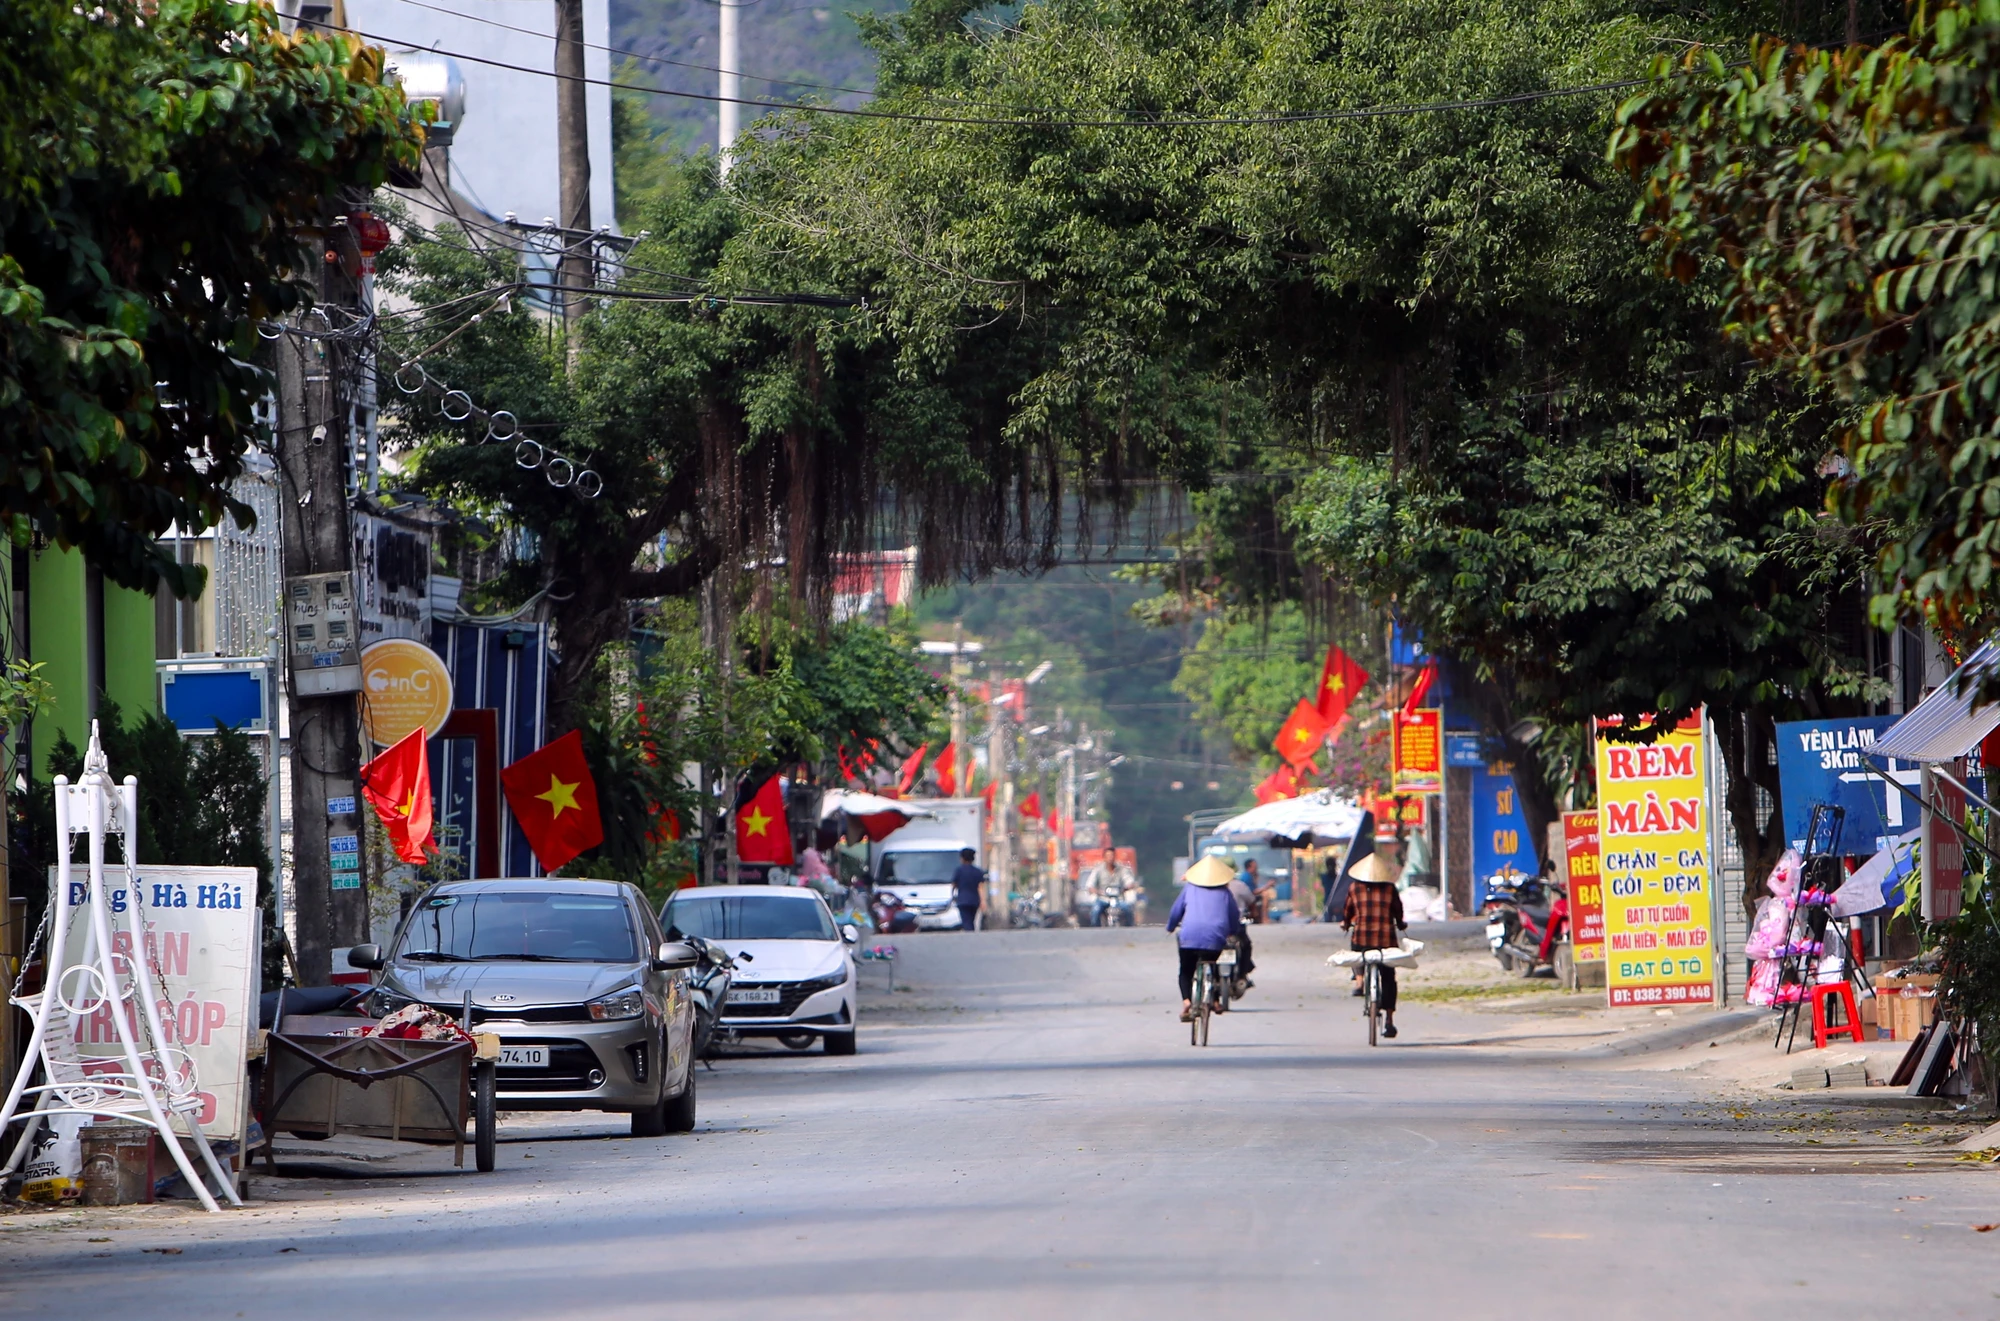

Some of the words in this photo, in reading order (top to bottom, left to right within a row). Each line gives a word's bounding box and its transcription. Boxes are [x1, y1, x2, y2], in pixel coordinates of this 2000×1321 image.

[1799, 728, 1834, 752] YÊN
[1837, 726, 1875, 749] LÂM
[1820, 750, 1859, 769] 3Km
[1606, 792, 1699, 834] MÀN
[1493, 829, 1518, 855] CAO
[1607, 849, 1656, 870] CHĂN
[1678, 850, 1704, 868] GA
[1663, 872, 1701, 895] ĐỆM
[151, 884, 188, 908] Hà
[196, 882, 242, 909] Hải
[1577, 885, 1603, 909] BẠ
[1612, 931, 1632, 950] MÁI
[1667, 929, 1686, 947] MÁI
[1621, 961, 1655, 980] BẠT
[1661, 957, 1673, 975] Ô
[1678, 956, 1701, 974] TÔ
[1613, 989, 1631, 1002] ĐT:
[1633, 988, 1662, 1001] 0382
[1665, 987, 1686, 1000] 390
[1689, 985, 1711, 999] 448
[498, 1050, 541, 1063] 74.10
[24, 1166, 61, 1181] STARK
